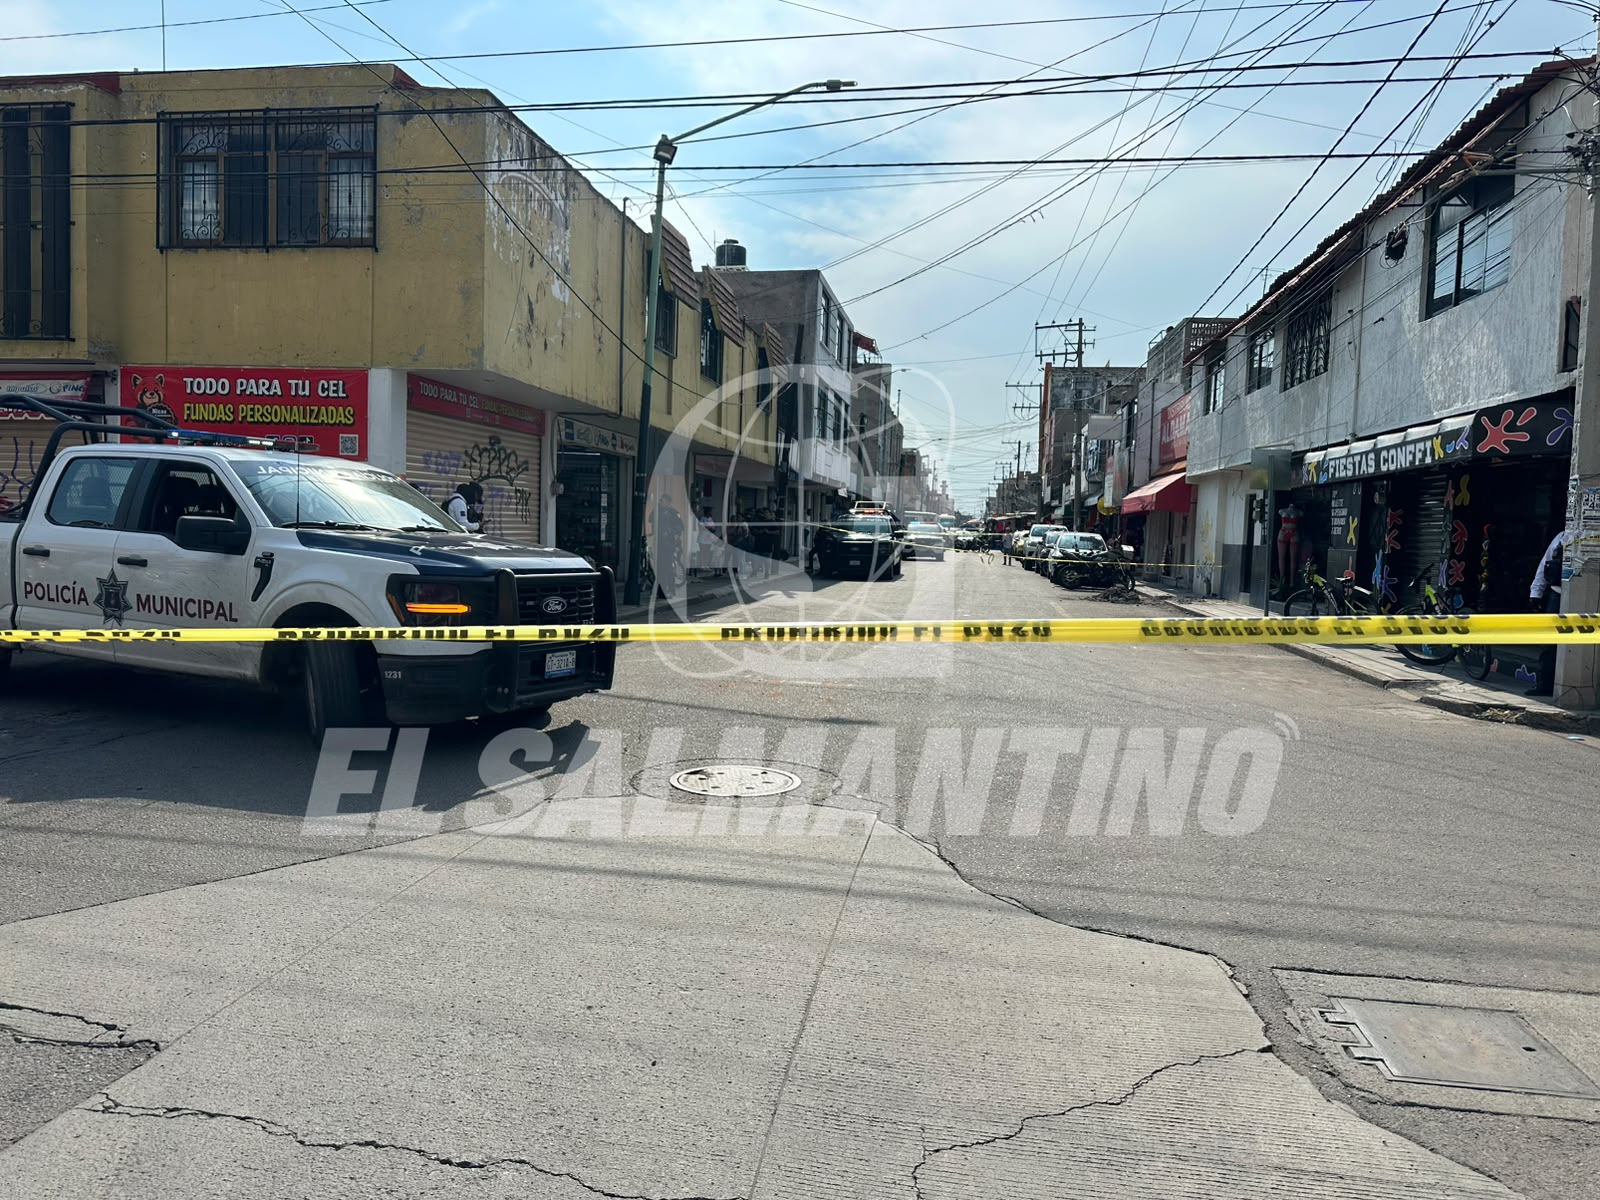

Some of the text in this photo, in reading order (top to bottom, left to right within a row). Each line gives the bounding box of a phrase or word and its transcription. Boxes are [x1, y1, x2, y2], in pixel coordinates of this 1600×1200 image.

[183, 377, 347, 398] TODO PARA TU CEL
[419, 382, 438, 398] TODO
[440, 387, 458, 404] PARA
[459, 392, 467, 406] TU
[468, 395, 480, 409] CEL
[183, 403, 354, 425] FUNDAS PERSONALIZADAS
[1328, 440, 1432, 479] FIESTAS CONFFI
[24, 581, 239, 623] POLICÍA MUNICIPAL
[547, 600, 563, 611] Ford
